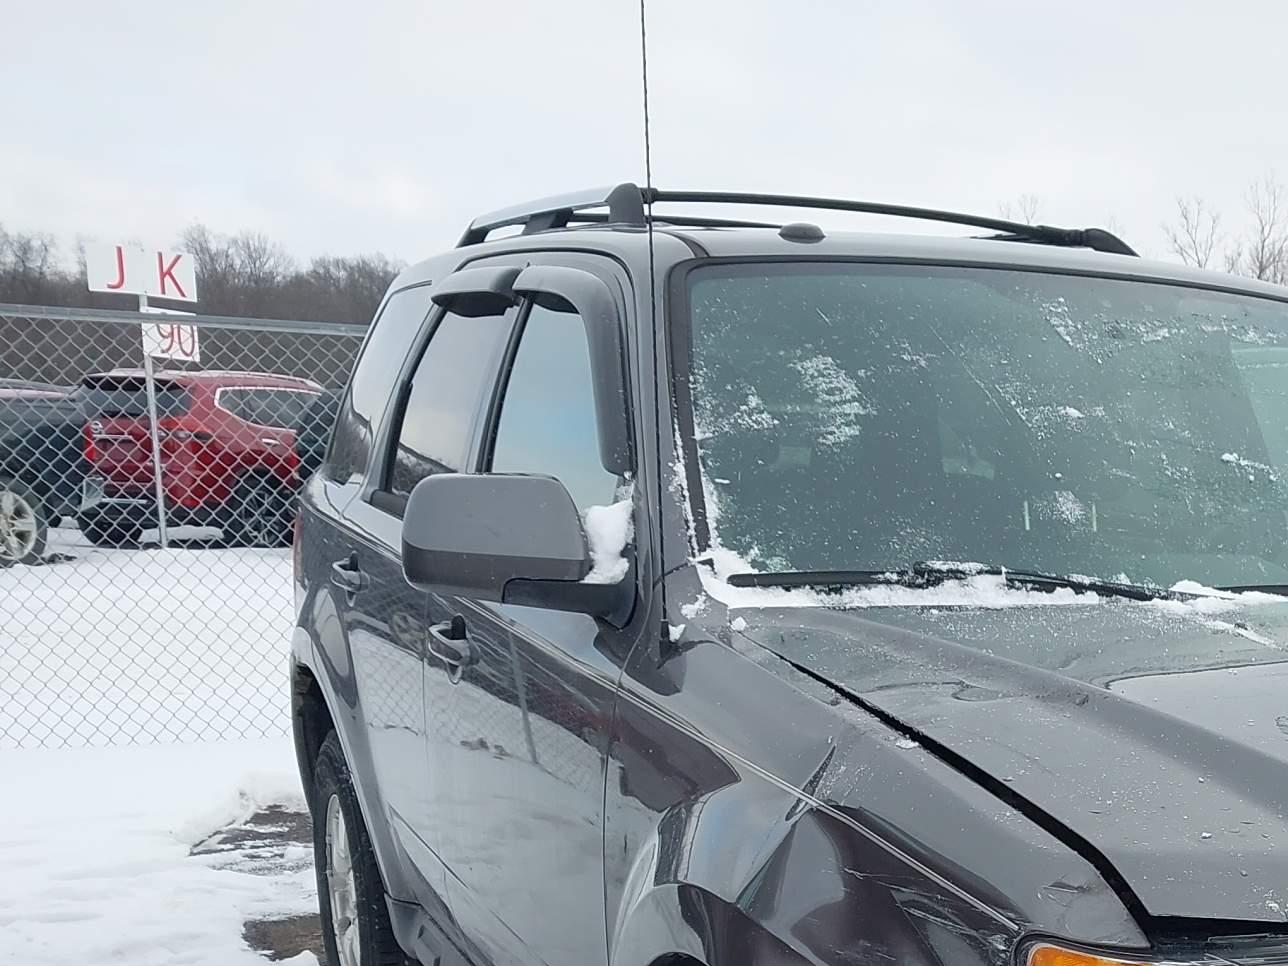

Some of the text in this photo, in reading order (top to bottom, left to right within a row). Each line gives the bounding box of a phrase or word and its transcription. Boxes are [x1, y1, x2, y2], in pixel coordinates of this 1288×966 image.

[106, 246, 187, 298] J K
[155, 322, 196, 358] 90
